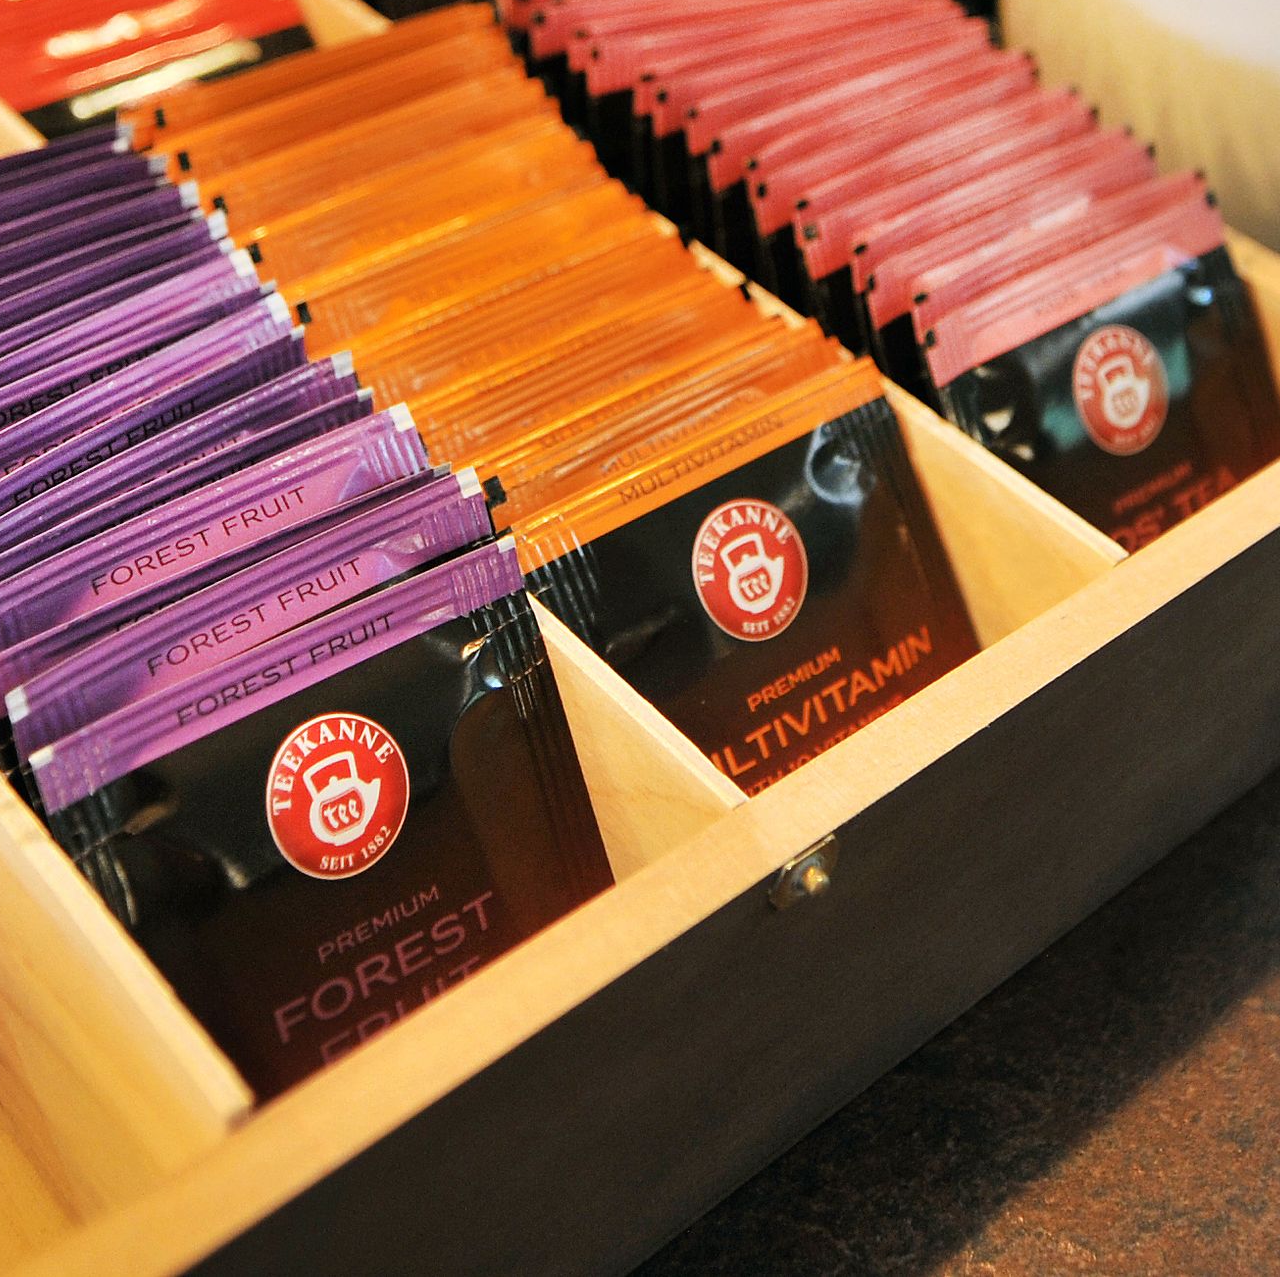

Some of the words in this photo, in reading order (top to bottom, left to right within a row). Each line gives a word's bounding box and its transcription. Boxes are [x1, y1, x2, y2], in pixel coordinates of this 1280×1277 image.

[12, 441, 120, 507] FOREST
[125, 399, 202, 446] FRUIT
[619, 412, 784, 504] MULTIVITAMIN
[91, 527, 212, 596] FOREST
[221, 486, 305, 537] FRUIT
[698, 505, 795, 587] TEEKANNE
[146, 602, 266, 678] FOREST
[276, 556, 362, 612] FRUIT
[175, 655, 299, 727] FOREST
[309, 611, 396, 666] FRUIT
[746, 645, 842, 713] PREMIUM
[272, 719, 395, 816] TEEKANNE
[320, 852, 355, 871] SEIT
[360, 824, 392, 860] 1882
[273, 890, 494, 1044] FOREST
[317, 884, 440, 964] PREMIUM
